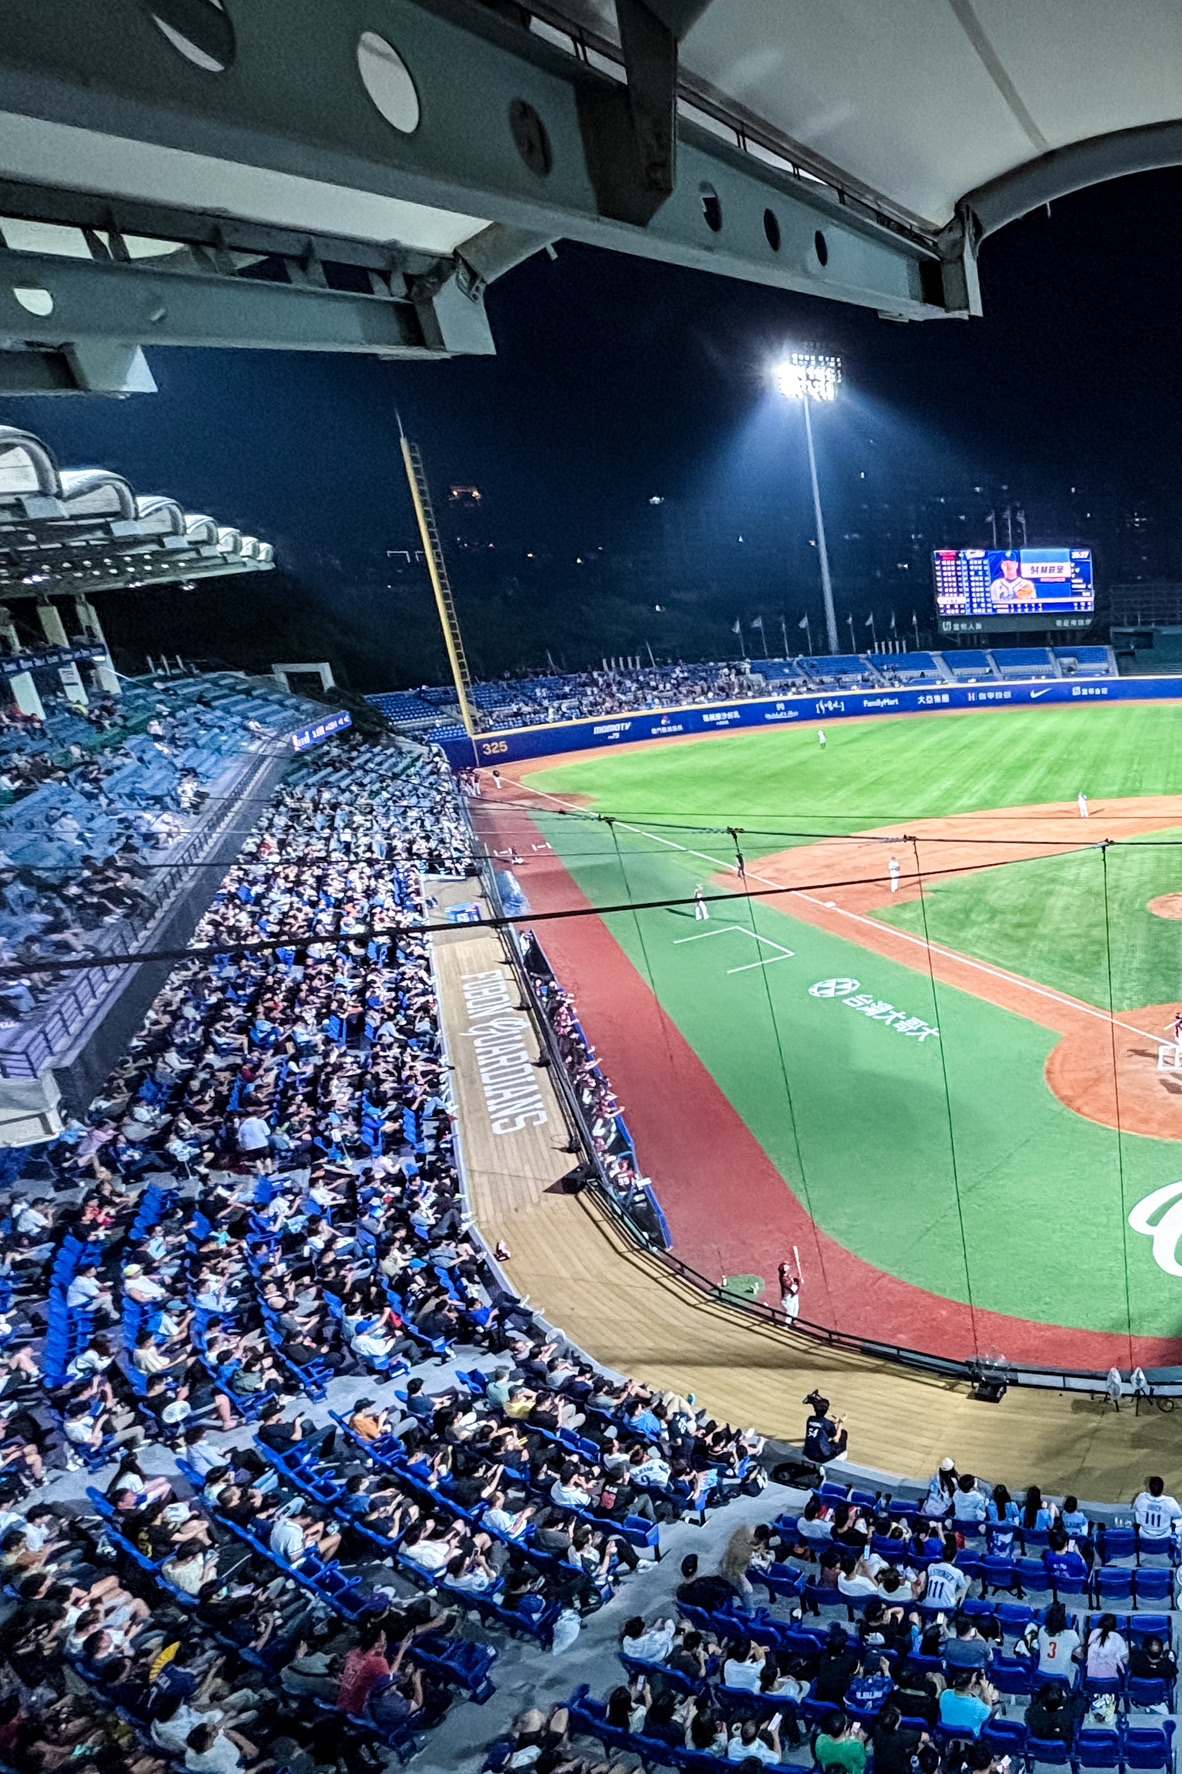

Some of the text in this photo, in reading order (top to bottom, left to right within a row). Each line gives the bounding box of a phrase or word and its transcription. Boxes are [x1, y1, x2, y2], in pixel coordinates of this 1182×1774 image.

[863, 698, 899, 708] FamilyMart
[482, 741, 508, 755] 325
[842, 994, 940, 1042] 台灣大哥大
[459, 969, 547, 1135] FUBON GUARDIANS
[1145, 1512, 1161, 1527] 111
[1047, 1641, 1057, 1659] 3
